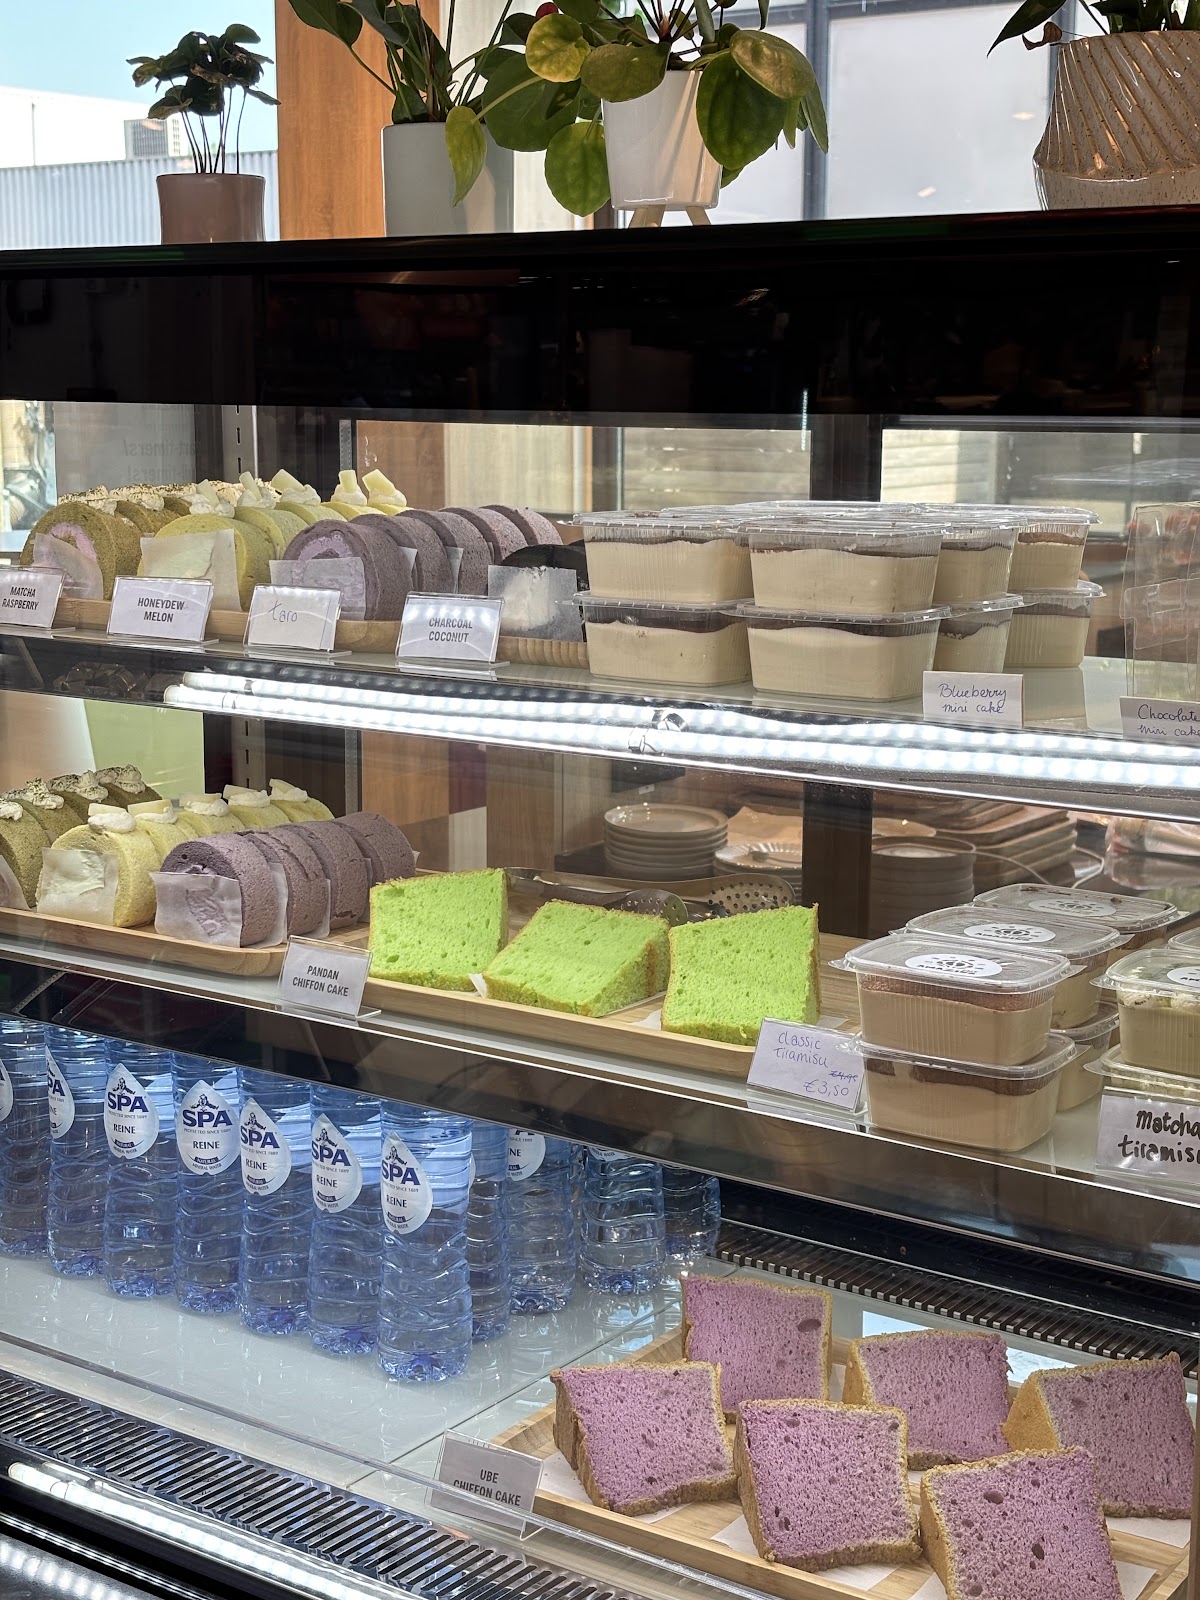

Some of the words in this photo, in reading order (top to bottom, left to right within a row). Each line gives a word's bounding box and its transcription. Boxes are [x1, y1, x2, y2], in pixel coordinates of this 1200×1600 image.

[10, 586, 36, 598] MATCHA
[1, 598, 39, 610] RASPBERRY
[137, 597, 185, 610] HONEYDEW
[143, 611, 174, 622] MELON
[267, 599, 298, 623] taro
[428, 618, 473, 629] CHARCOAL
[428, 631, 470, 643] COCONUT
[938, 683, 1007, 709] Blueberry
[942, 701, 968, 713] mini
[976, 701, 1004, 714] cake
[1137, 703, 1200, 723] Chocolate
[1137, 724, 1168, 736] mini
[306, 965, 340, 980] PANDAN
[292, 976, 326, 992] CHIFFON
[326, 984, 349, 997] CAKE
[802, 1078, 849, 1097] €3,50
[107, 1091, 149, 1113] SPA
[182, 1109, 233, 1128] SPA
[113, 1123, 136, 1134] REINE
[240, 1125, 280, 1149] SPA
[192, 1140, 220, 1150] REINE
[311, 1140, 352, 1167] SPA
[245, 1158, 268, 1171] REINE
[381, 1159, 421, 1186] SPA
[316, 1174, 338, 1188] REINE
[386, 1194, 407, 1208] REINE
[479, 1469, 499, 1484] UBE
[495, 1490, 522, 1507] CAKE
